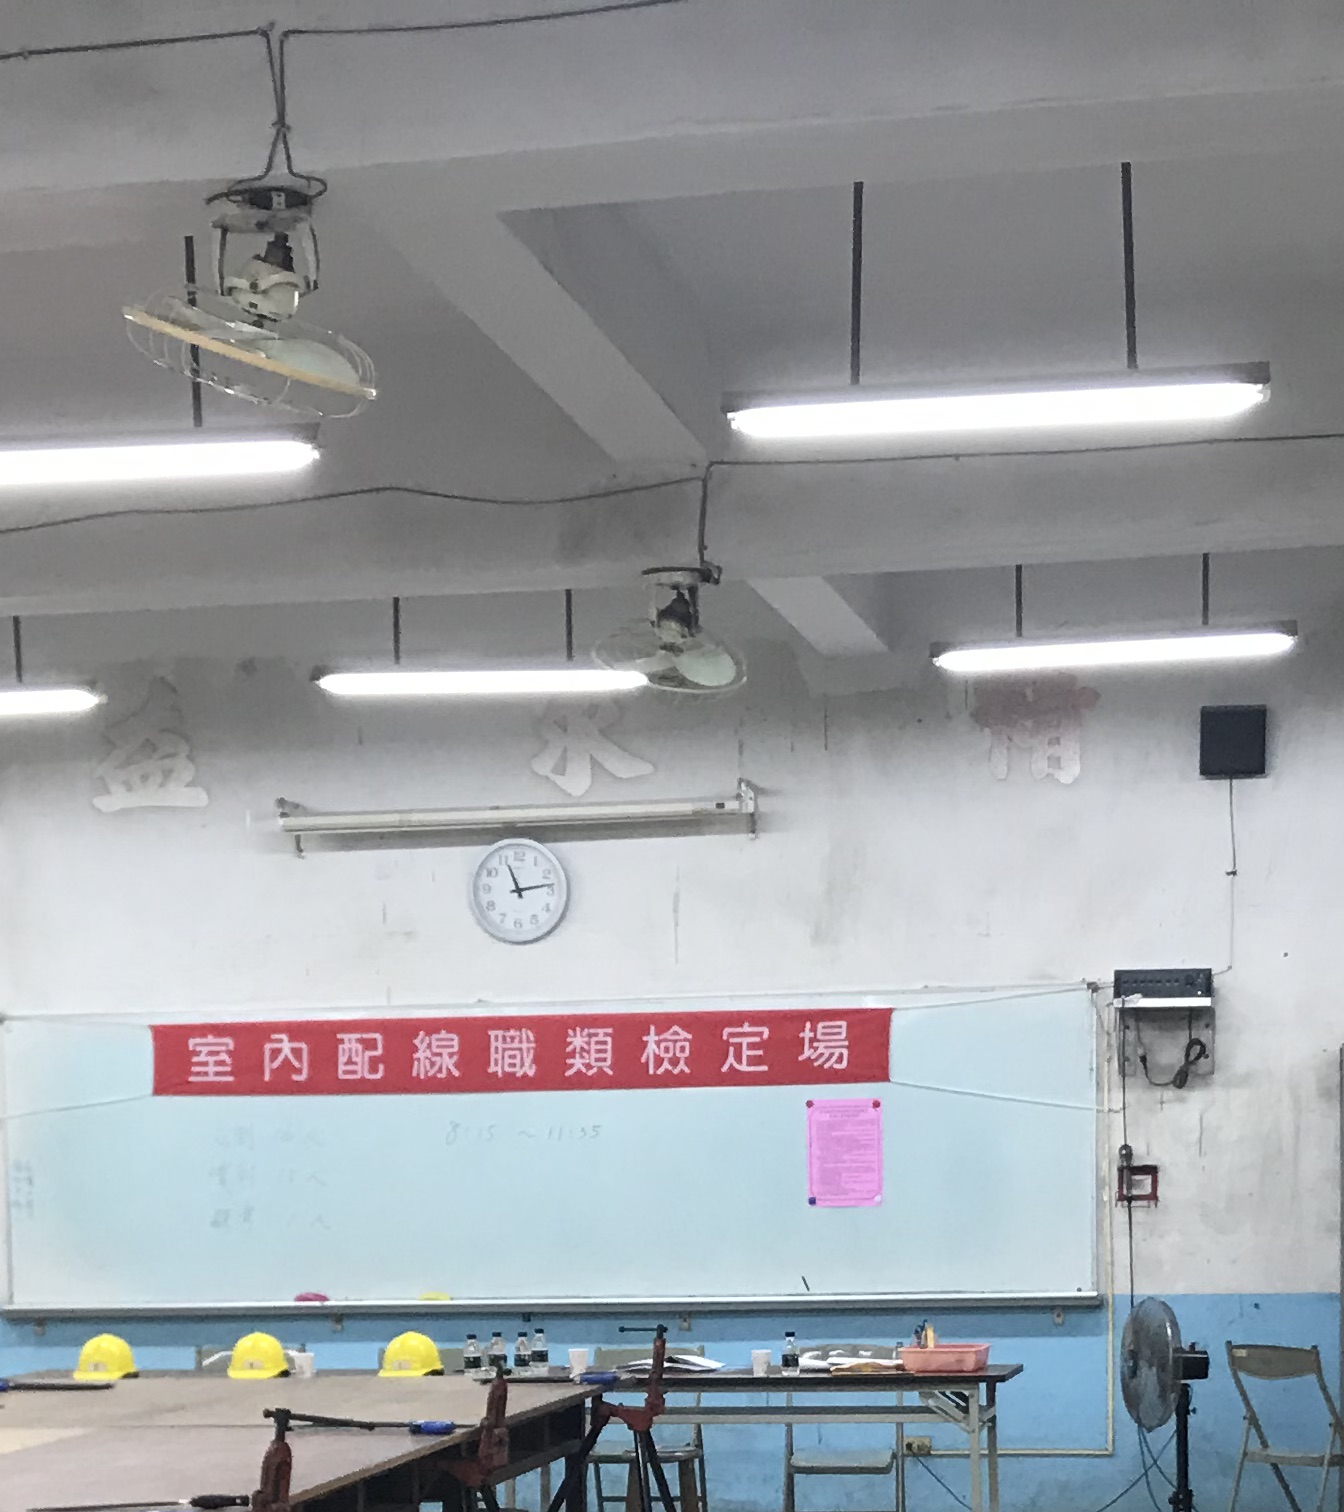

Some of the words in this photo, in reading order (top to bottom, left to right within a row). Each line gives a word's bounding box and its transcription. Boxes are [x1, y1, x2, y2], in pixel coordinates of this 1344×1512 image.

[513, 850, 526, 862] 12
[482, 883, 492, 894] 9
[485, 900, 496, 912] 8
[541, 902, 552, 914] 4
[498, 912, 507, 924] 7
[513, 918, 523, 929] 6
[187, 1020, 850, 1082] 室內配線職類檢定場
